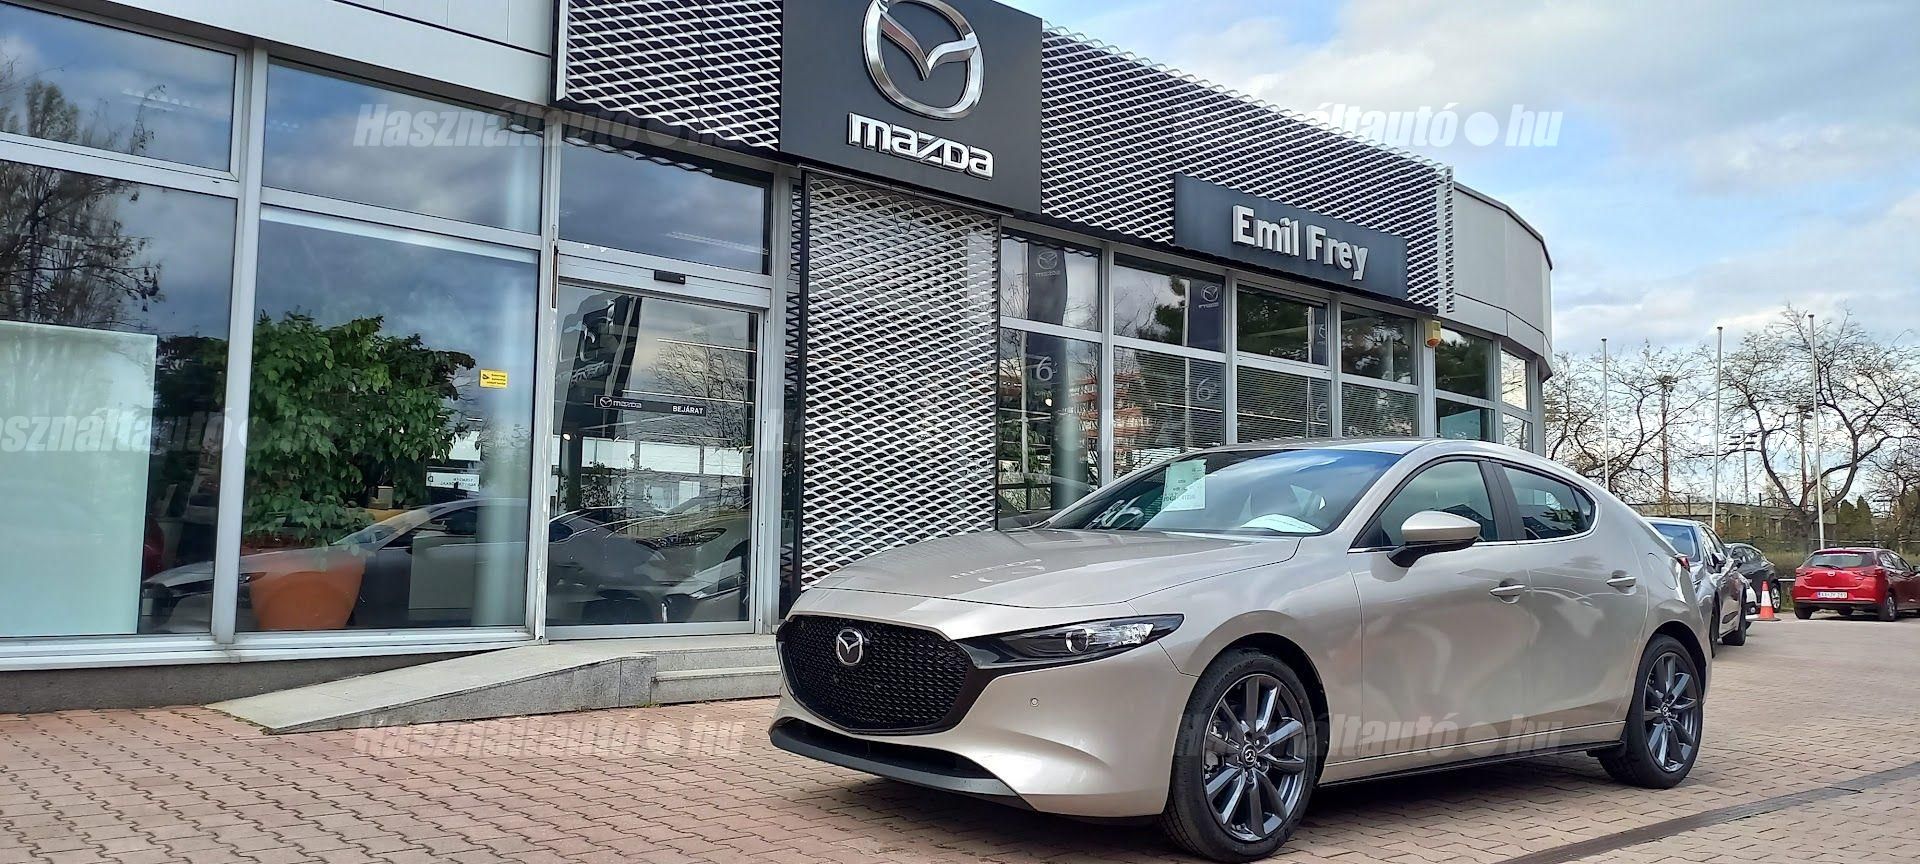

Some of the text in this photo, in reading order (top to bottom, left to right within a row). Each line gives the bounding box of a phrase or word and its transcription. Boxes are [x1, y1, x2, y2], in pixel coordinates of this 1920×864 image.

[1232, 205, 1369, 280] Emil Frey
[672, 404, 704, 415] BEJÁRAT
